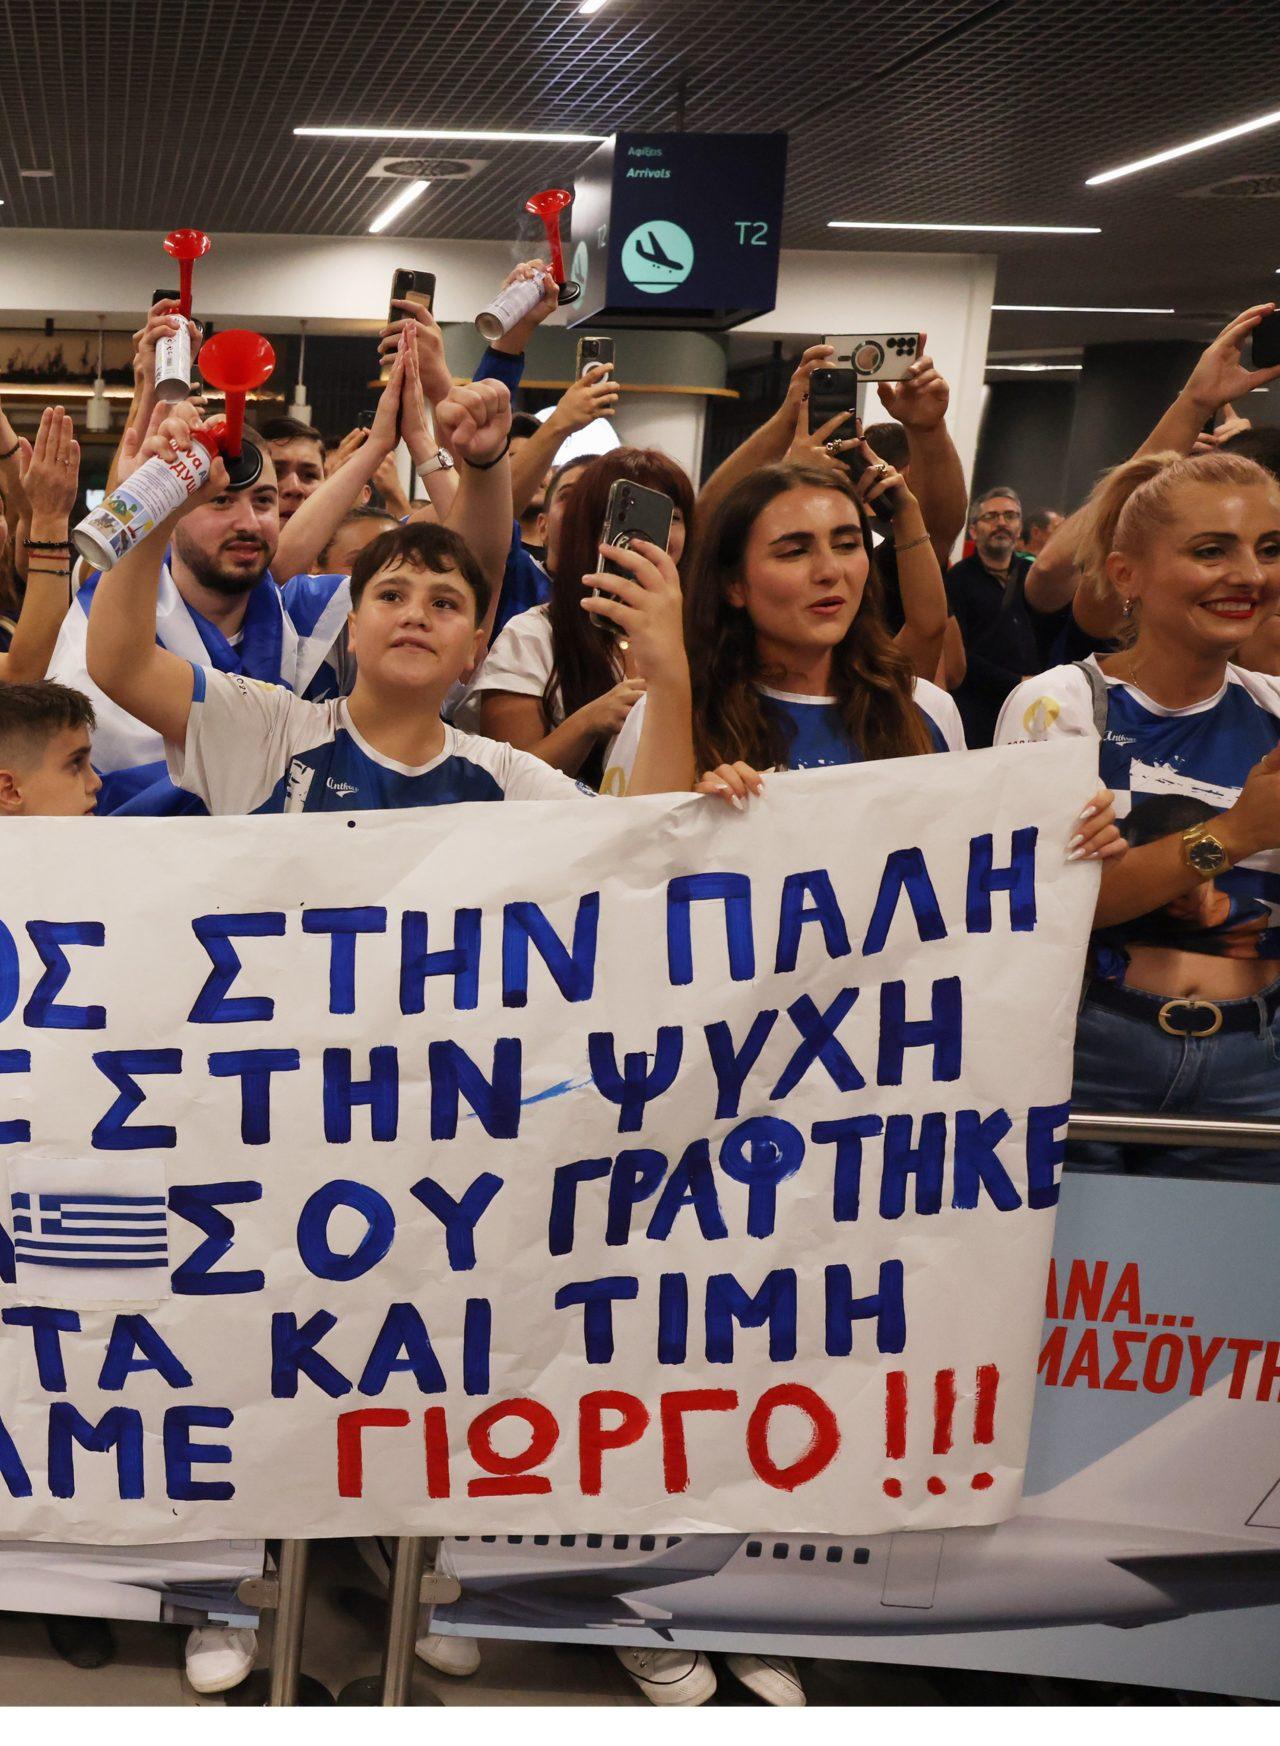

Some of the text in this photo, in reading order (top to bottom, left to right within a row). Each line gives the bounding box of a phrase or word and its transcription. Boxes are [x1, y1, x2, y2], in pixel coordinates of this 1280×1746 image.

[626, 168, 671, 179] Arrivals
[734, 221, 769, 246] T2
[187, 891, 599, 1024] ΣΤΗΝ
[666, 826, 1039, 986] ΠΑΛΗ
[91, 1037, 521, 1150] ΣΤΗΝ
[587, 976, 963, 1133] ΨΥΧΗ
[168, 1171, 505, 1295] ΣΟΥ
[548, 1101, 1071, 1256] ΓΡΑΦΤΗΚΕ
[270, 1296, 493, 1399] ΚΑΙ
[554, 1258, 907, 1365] ΤΙΜΗ
